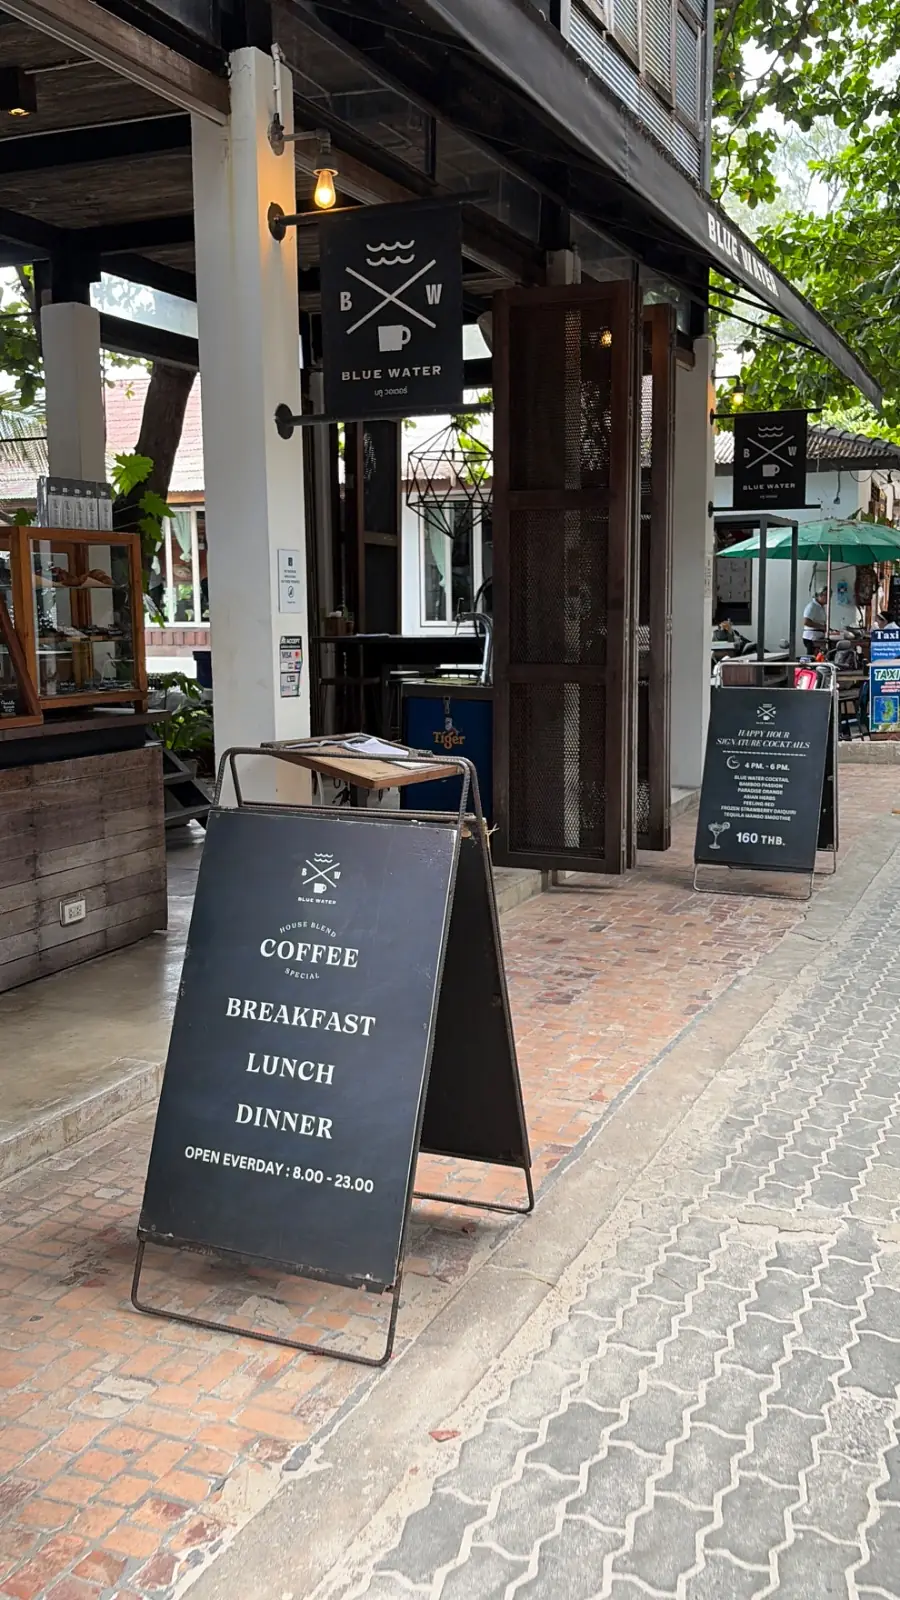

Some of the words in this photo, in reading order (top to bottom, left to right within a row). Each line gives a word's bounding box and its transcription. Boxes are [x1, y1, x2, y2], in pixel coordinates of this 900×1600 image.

[707, 212, 740, 263] BLUE
[740, 242, 780, 297] WATER
[340, 292, 352, 311] B
[426, 284, 442, 304] W
[342, 370, 382, 381] BLUE
[388, 366, 442, 378] WATER
[743, 448, 750, 458] B
[788, 446, 797, 456] W
[875, 631, 900, 640] Taxi
[874, 669, 900, 681] TAXI
[432, 731, 466, 749] Tiger
[738, 729, 764, 737] HAPPY
[716, 738, 762, 747] SIGNATURE
[763, 740, 810, 749] COCKTAILS
[736, 832, 758, 844] 160
[761, 836, 786, 846] THB.
[301, 868, 307, 876] B
[334, 871, 341, 880] W
[279, 921, 308, 934] HOUSE
[311, 922, 337, 938] BLEND
[260, 938, 359, 968] COFFEE
[284, 968, 320, 980] SPECIAL
[226, 996, 376, 1036] BREAKFAST
[246, 1052, 336, 1085] LUNCH
[235, 1103, 333, 1140] DINNER
[184, 1145, 220, 1164] OPEN
[223, 1153, 284, 1176] EVERDAY
[292, 1166, 324, 1184] 8.00
[334, 1174, 374, 1193] 23.00
